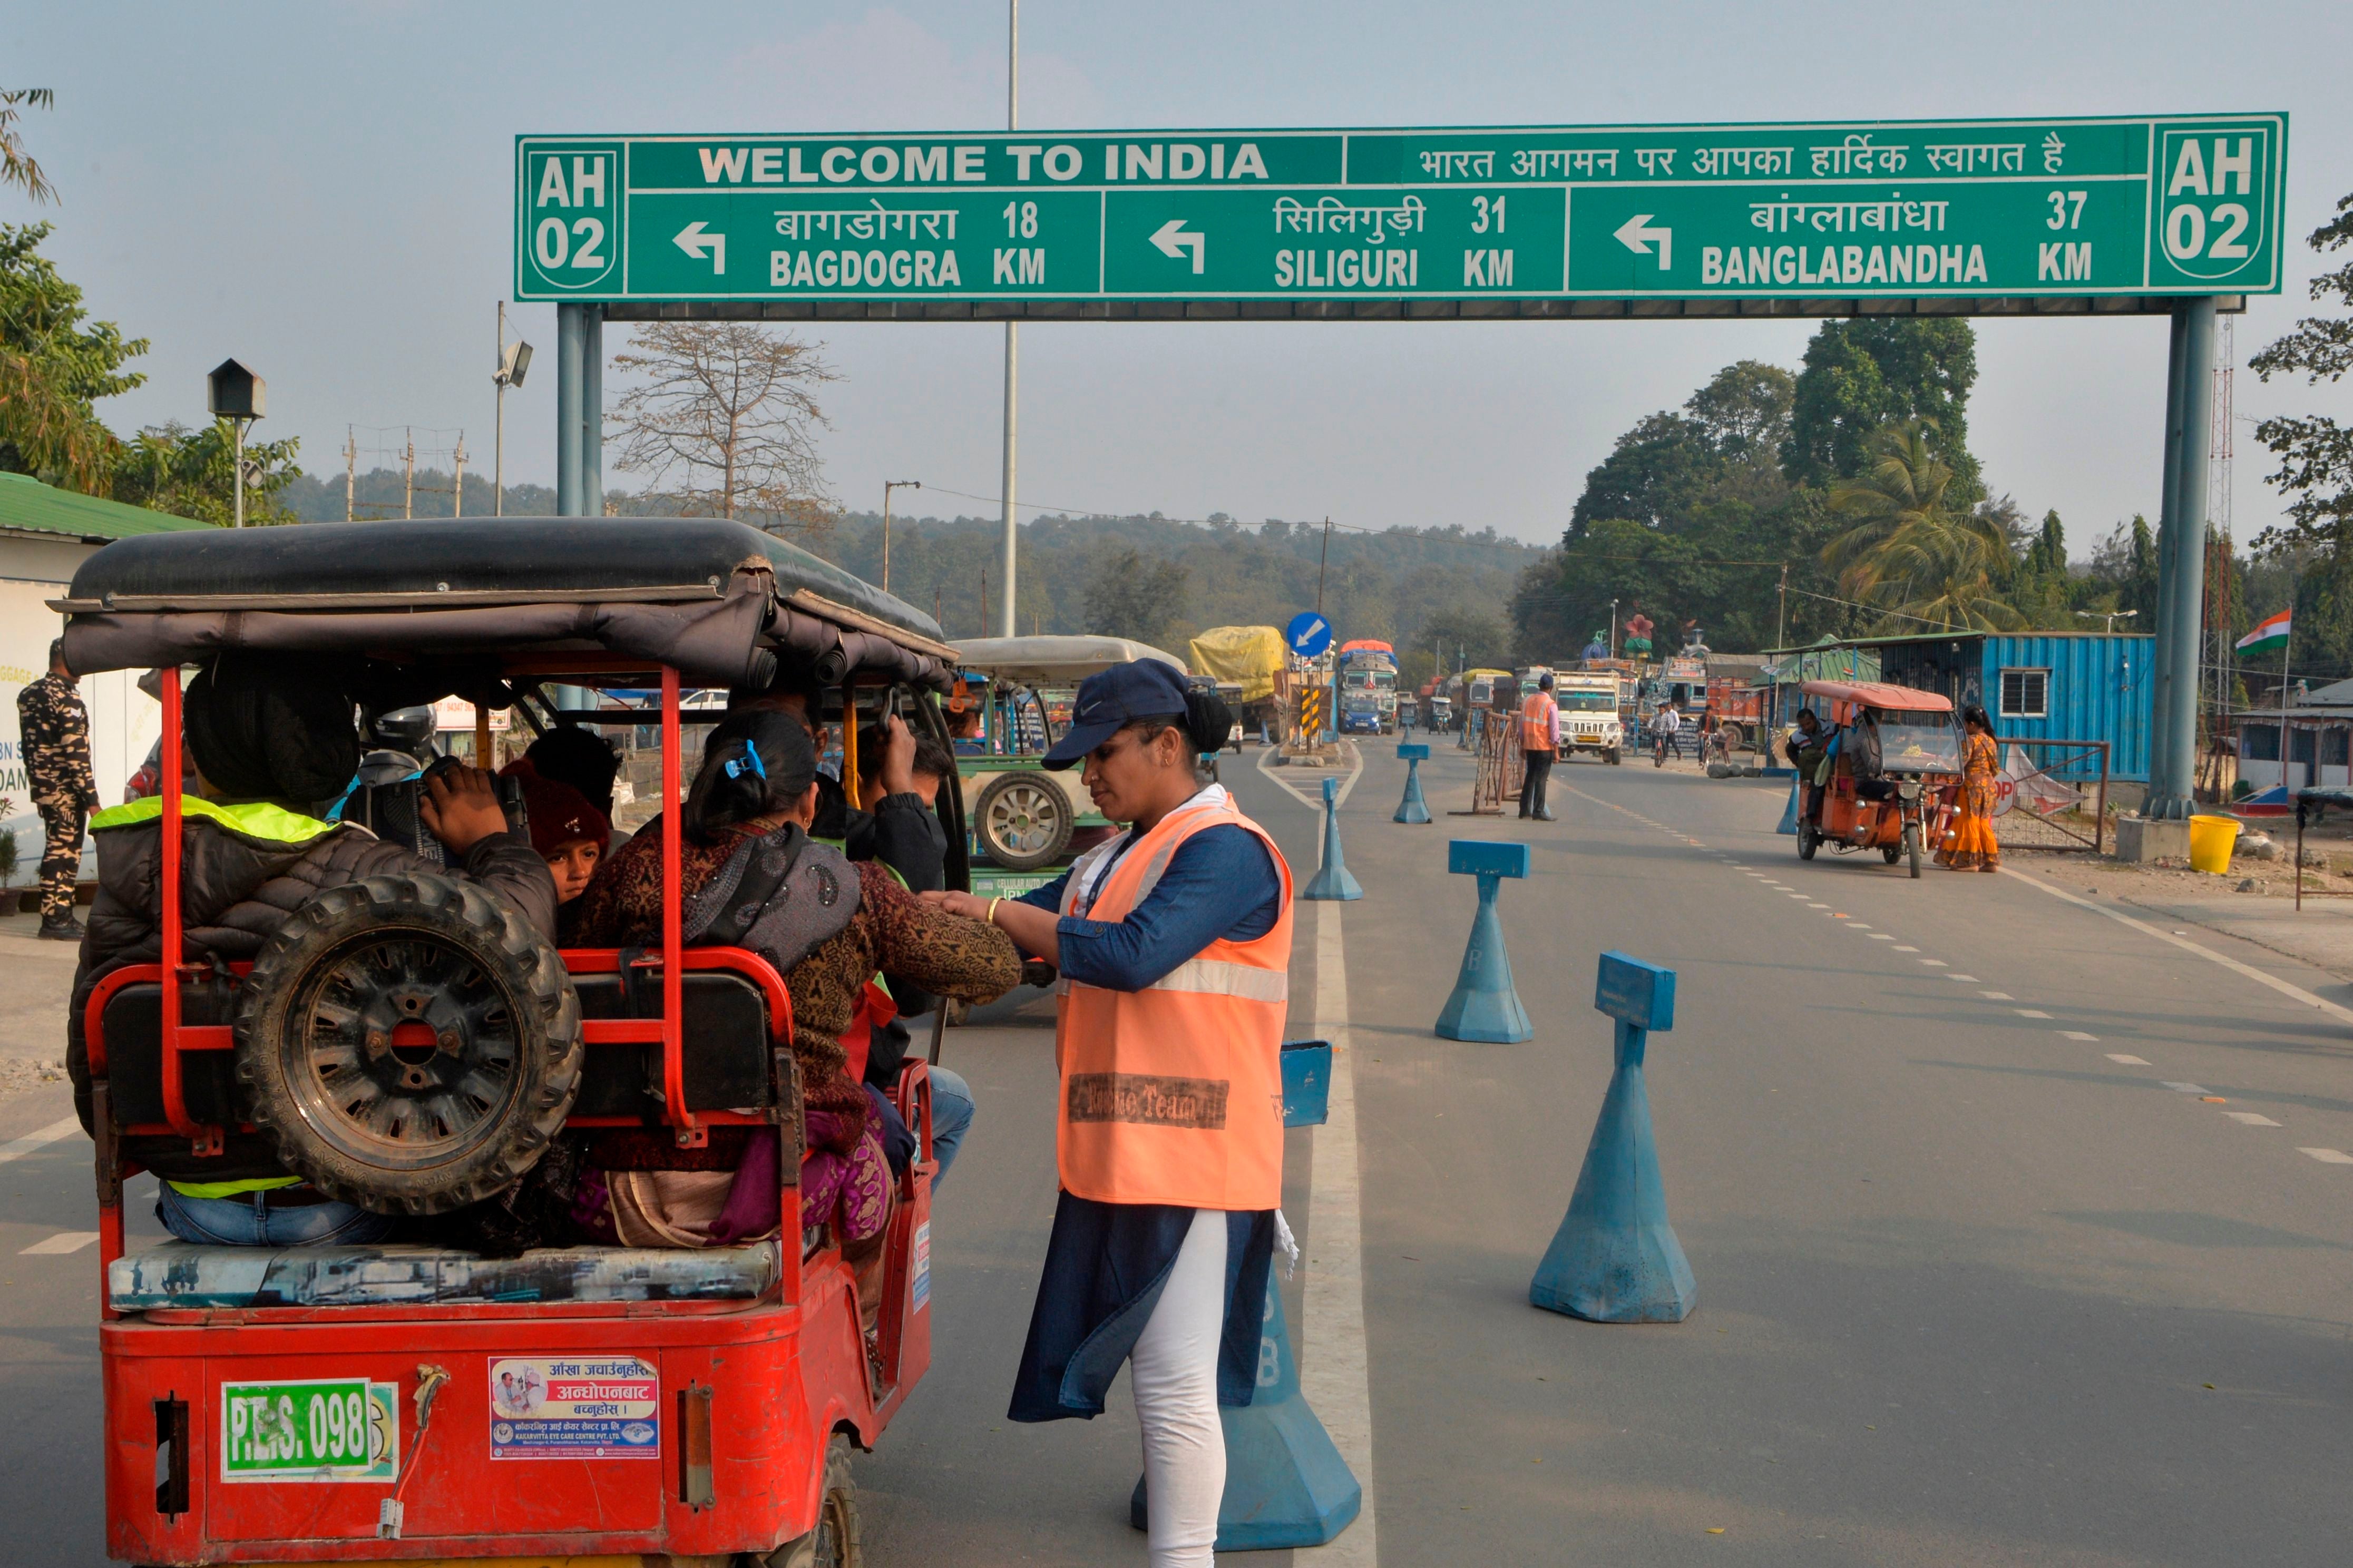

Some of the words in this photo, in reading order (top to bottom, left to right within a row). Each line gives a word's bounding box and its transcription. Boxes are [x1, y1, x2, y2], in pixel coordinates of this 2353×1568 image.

[699, 146, 985, 182] WELCOME
[1007, 145, 1082, 180] TO
[1106, 144, 1268, 179] INDIA
[1420, 151, 1495, 178] भारत
[1511, 150, 1619, 177] आगमन
[1635, 149, 1676, 175] पर
[1693, 148, 1793, 174] आपका
[1809, 134, 1910, 173] हार्दिक
[1925, 144, 2025, 171] स्वागत
[2042, 132, 2065, 173] है
[2170, 138, 2252, 197] AH
[536, 156, 604, 208] AH
[775, 199, 959, 239] बागडोगरा
[1004, 202, 1037, 238] 18
[1273, 195, 1426, 243] सिलिगुड़ी
[1472, 196, 1505, 233] 31
[1750, 193, 1949, 232] बांग्लाबांधा
[2047, 191, 2087, 229] 37
[2168, 204, 2250, 260] 02
[535, 218, 605, 270] 02
[1703, 245, 1987, 283] BANGLABANDHA
[2039, 242, 2091, 280] KM
[771, 250, 960, 286] BAGDOGRA
[994, 249, 1044, 283] KM
[1275, 250, 1417, 286] SILIGURI
[1464, 250, 1513, 286] KM
[997, 878, 1024, 889] CELLULAR
[1026, 878, 1040, 888] AUTO
[1143, 1084, 1197, 1121] Team
[310, 1393, 365, 1459] 098
